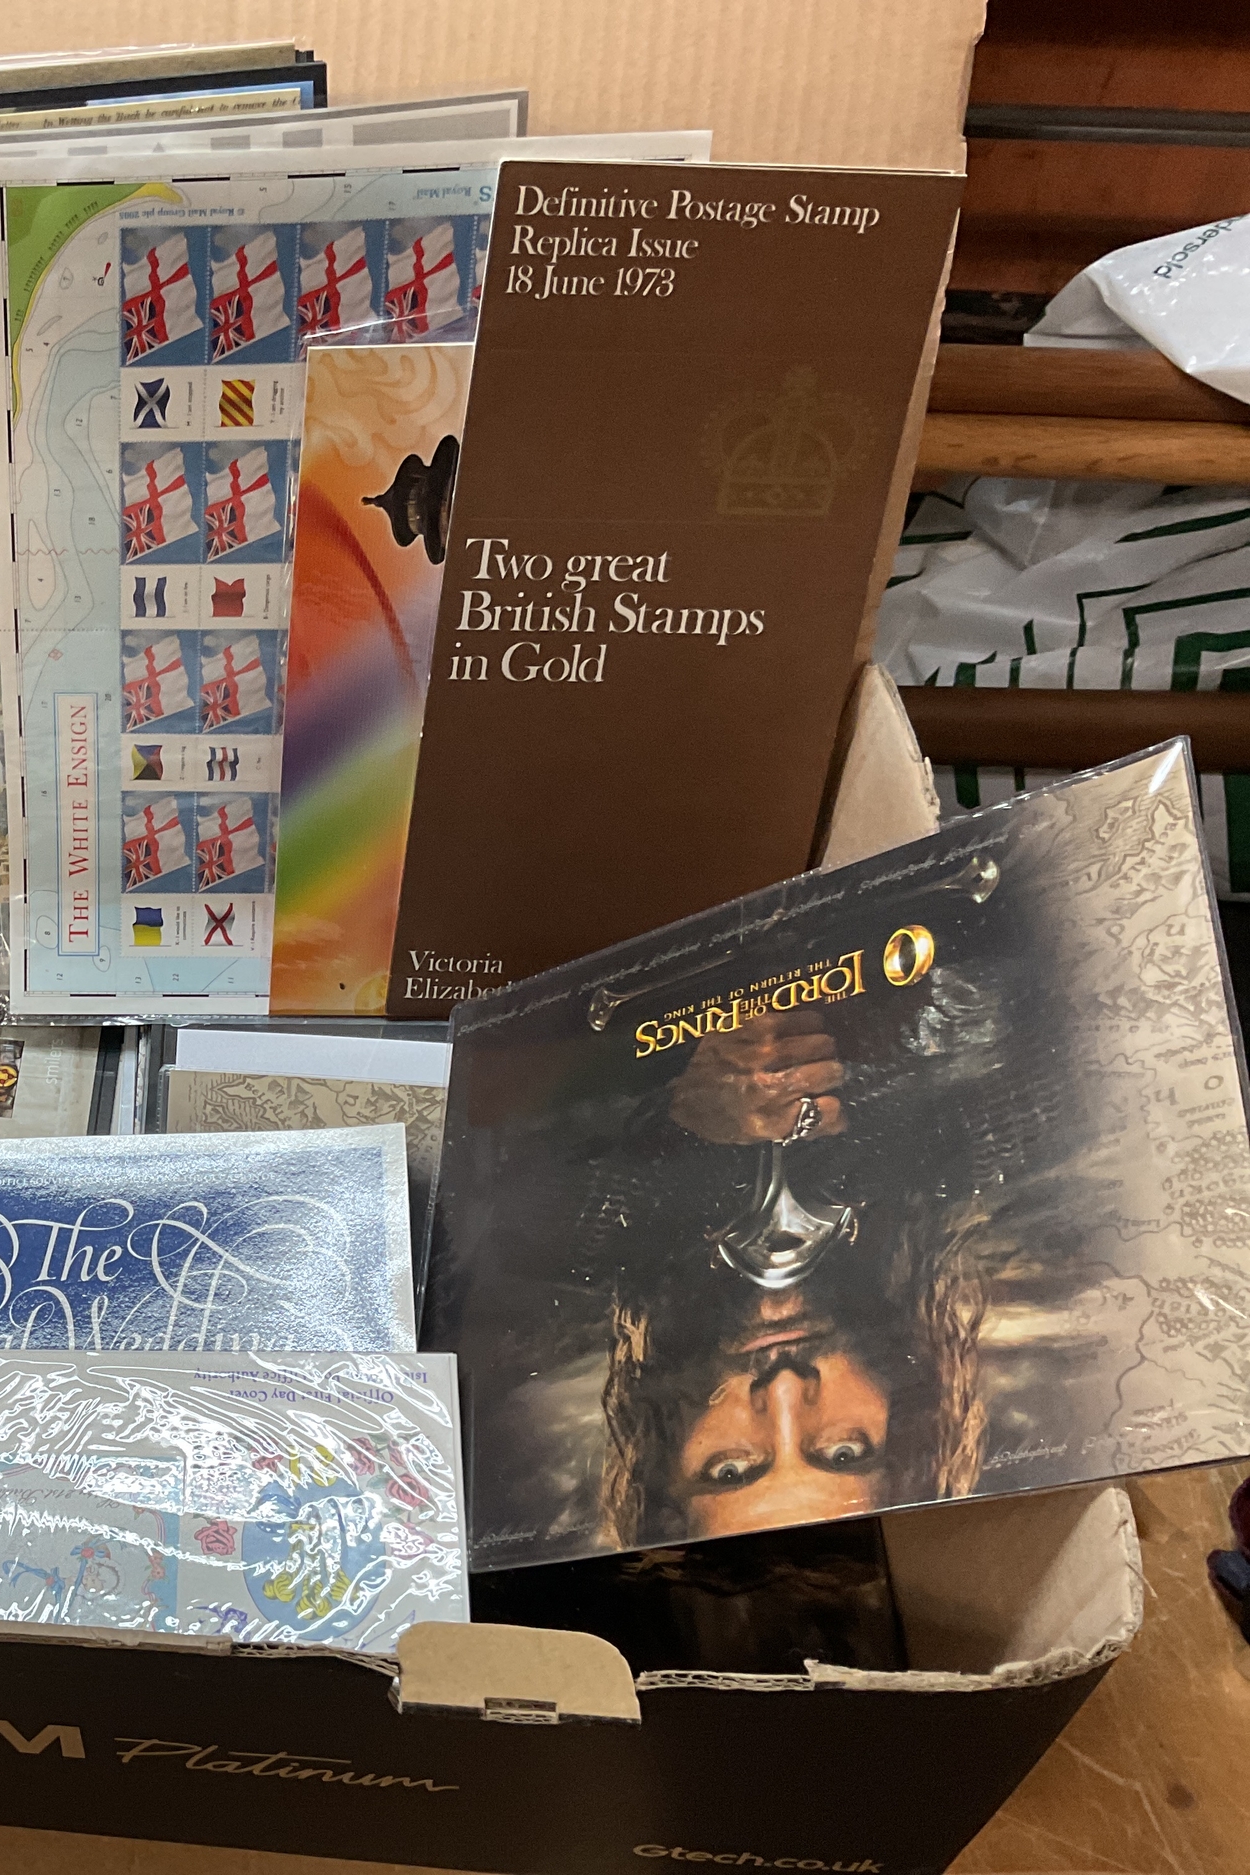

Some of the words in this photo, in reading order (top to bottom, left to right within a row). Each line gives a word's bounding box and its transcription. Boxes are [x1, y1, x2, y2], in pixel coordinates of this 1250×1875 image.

[515, 184, 658, 218] Definitive
[666, 190, 777, 228] Postage
[784, 193, 880, 234] Stamp
[510, 225, 617, 263] Replica
[627, 228, 699, 259] Issue
[506, 265, 532, 294] 18
[535, 265, 604, 299] June
[614, 268, 676, 296] 1973
[465, 538, 553, 581] Two
[561, 550, 671, 592] great
[456, 590, 596, 633] British
[608, 592, 766, 645] Stamps
[448, 642, 489, 682] in
[501, 640, 607, 684] Gold
[67, 705, 87, 787] ENSIGN
[68, 799, 89, 877] WHITE
[68, 890, 89, 943] THE
[408, 951, 503, 974] Victoria
[805, 957, 831, 973] THE
[723, 987, 745, 1000] OF
[747, 967, 802, 991] RETURN
[769, 948, 867, 1012] LORD
[698, 994, 722, 1008] THE
[737, 992, 771, 1012] THE
[742, 1003, 767, 1020] OF
[822, 989, 847, 1005] THE
[661, 1004, 695, 1021] KING
[634, 998, 740, 1058] RINGS
[43, 1037, 63, 1084] smilers
[192, 1365, 259, 1384] Authority
[227, 1388, 267, 1402] Cover
[270, 1387, 295, 1402] Day
[335, 1388, 394, 1404] Official
[114, 1735, 460, 1796] Platinum
[632, 1844, 884, 1874] Gtech.co.uk
